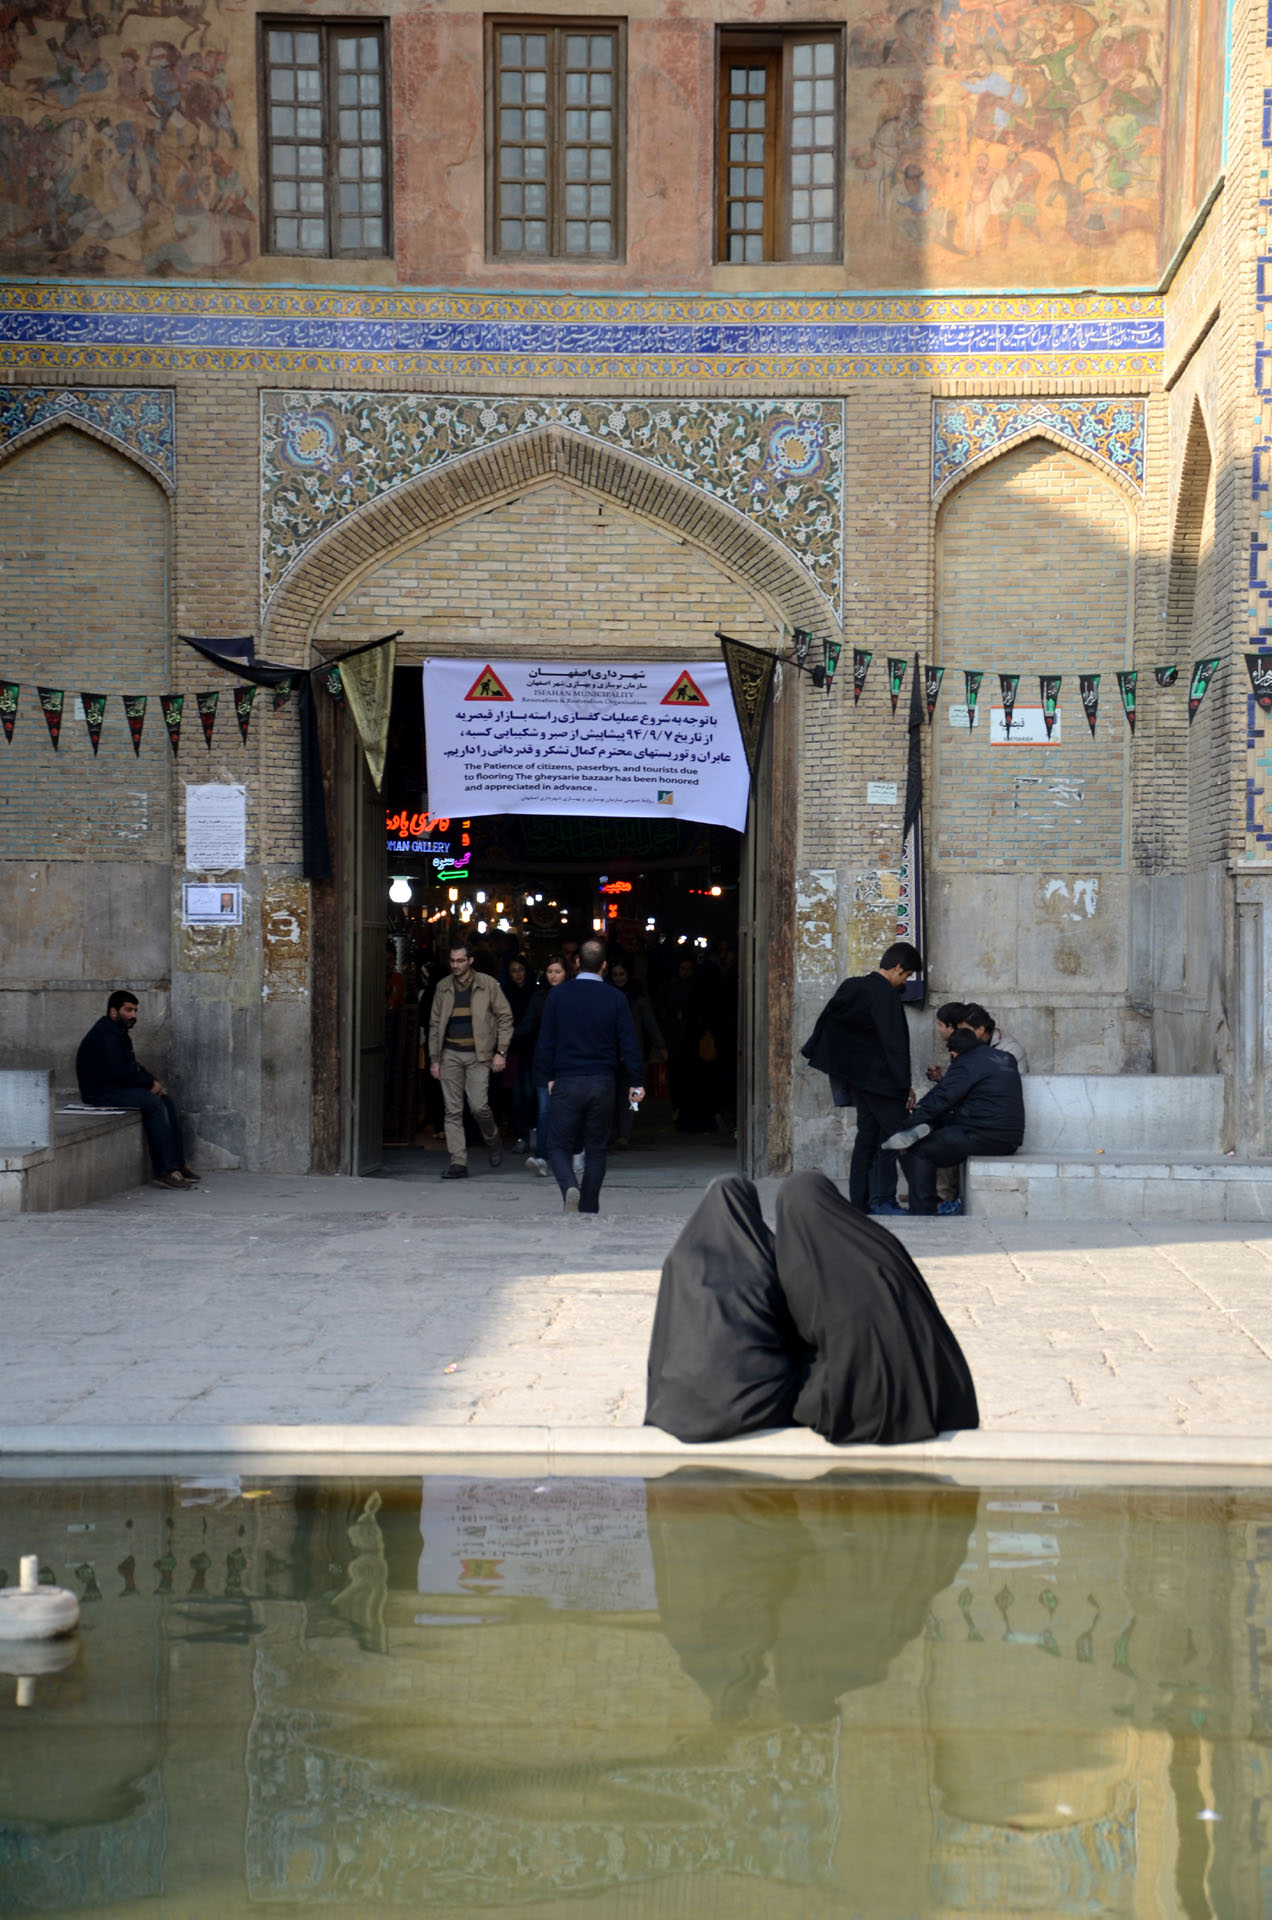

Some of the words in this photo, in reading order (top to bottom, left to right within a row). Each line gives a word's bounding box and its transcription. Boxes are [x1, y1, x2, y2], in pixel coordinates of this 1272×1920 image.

[528, 667, 591, 678] اصفهان
[591, 669, 646, 680] شهرداری
[566, 681, 591, 689] بهسازی
[597, 682, 623, 690] نوسازی
[623, 682, 648, 690] سازمان
[534, 689, 571, 697] ISFAHAN
[573, 690, 636, 699] MUNICIPALITY
[455, 709, 493, 722] قیصریه
[495, 710, 528, 723] بازار
[528, 711, 558, 723] راسته
[558, 711, 601, 724] کفسازی
[601, 712, 639, 724] عملیات
[640, 713, 672, 726] شروع
[494, 728, 539, 739] شکیبایی
[549, 730, 569, 740] صبر
[569, 729, 579, 740] از
[580, 729, 625, 741] پیشاپیش
[673, 732, 702, 745] تاریخ
[703, 733, 713, 745] از
[476, 745, 487, 757] را
[543, 745, 569, 757] تشکر
[570, 746, 598, 758] کمال
[598, 747, 633, 759] محترم
[697, 752, 731, 764] عابران
[483, 762, 523, 770] Patience
[536, 763, 575, 771] citizens,
[576, 764, 621, 773] paserbys,
[642, 766, 679, 774] tourists
[680, 767, 698, 775] due
[476, 772, 514, 781] flooring
[534, 773, 580, 782] gheysarie
[633, 775, 657, 783] been
[659, 776, 699, 785] honored
[464, 784, 483, 792] and
[484, 783, 541, 791] appreciated
[553, 783, 593, 791] advance
[411, 840, 451, 853] GALLERY
